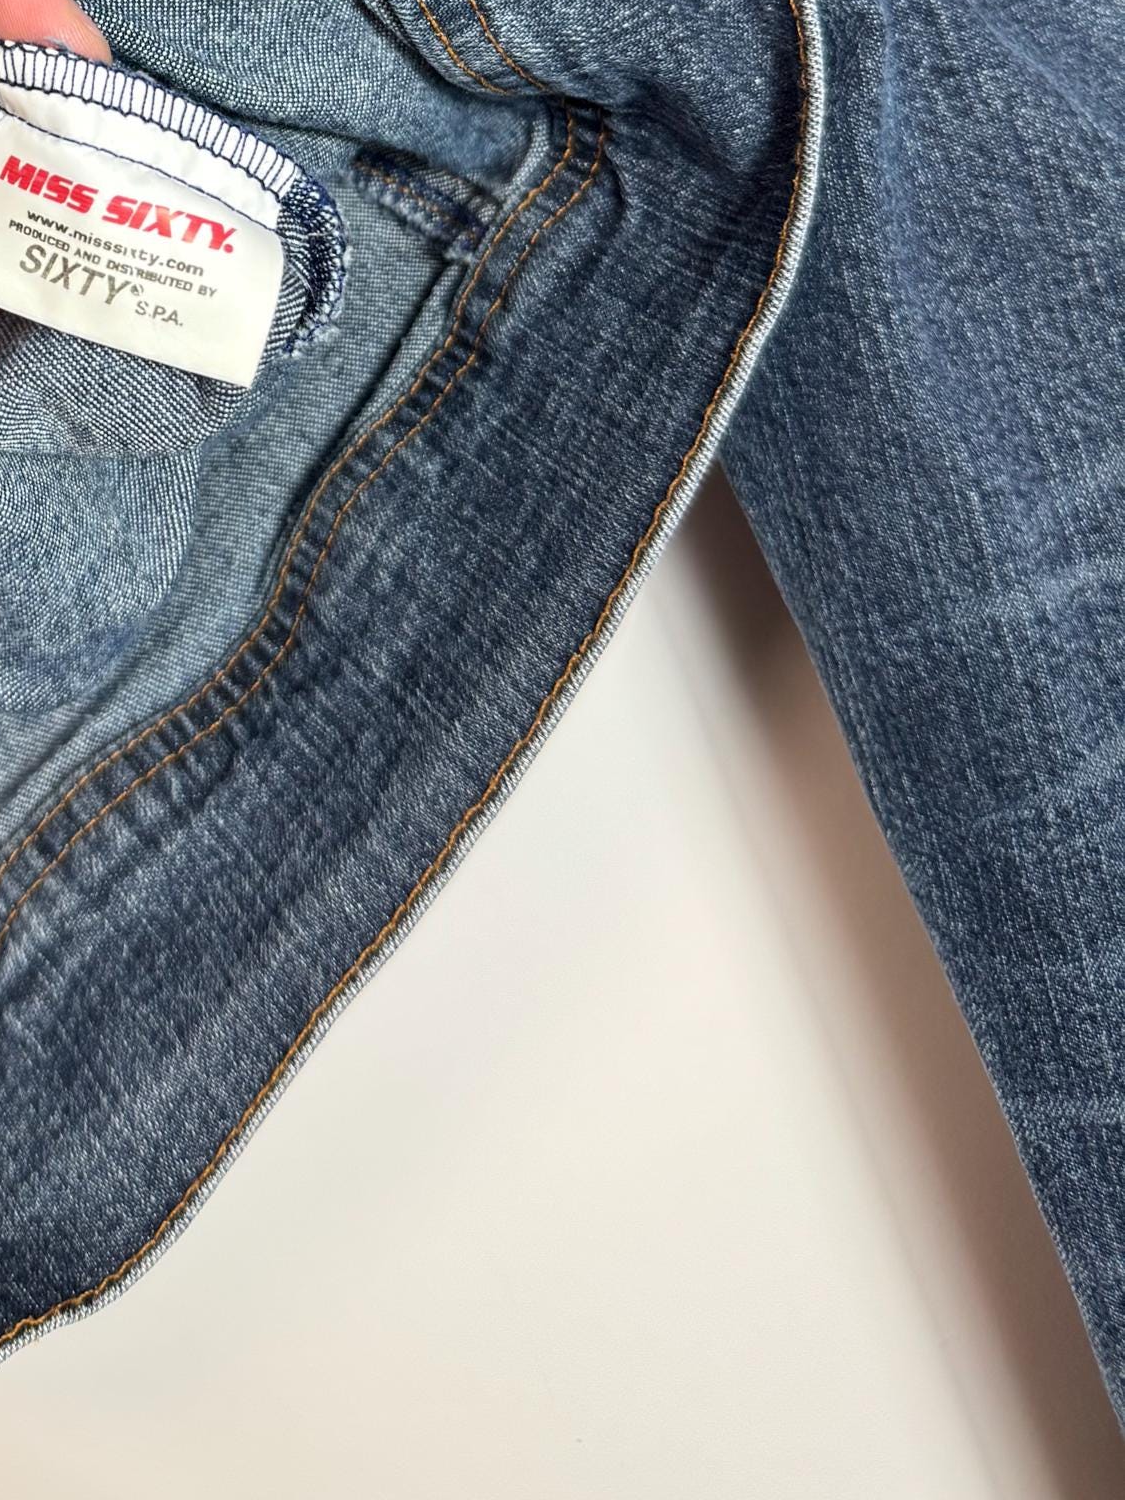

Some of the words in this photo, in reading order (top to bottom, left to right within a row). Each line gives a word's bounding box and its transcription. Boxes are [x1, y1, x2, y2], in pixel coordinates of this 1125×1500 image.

[0, 155, 98, 213] MISS
[9, 220, 70, 252] PRODUCED
[74, 249, 101, 265] AND
[106, 260, 193, 291] DISTRIBUTED
[198, 285, 218, 297] BY
[27, 210, 204, 276] www.misssixty.com
[135, 300, 184, 326] S.P.A.
